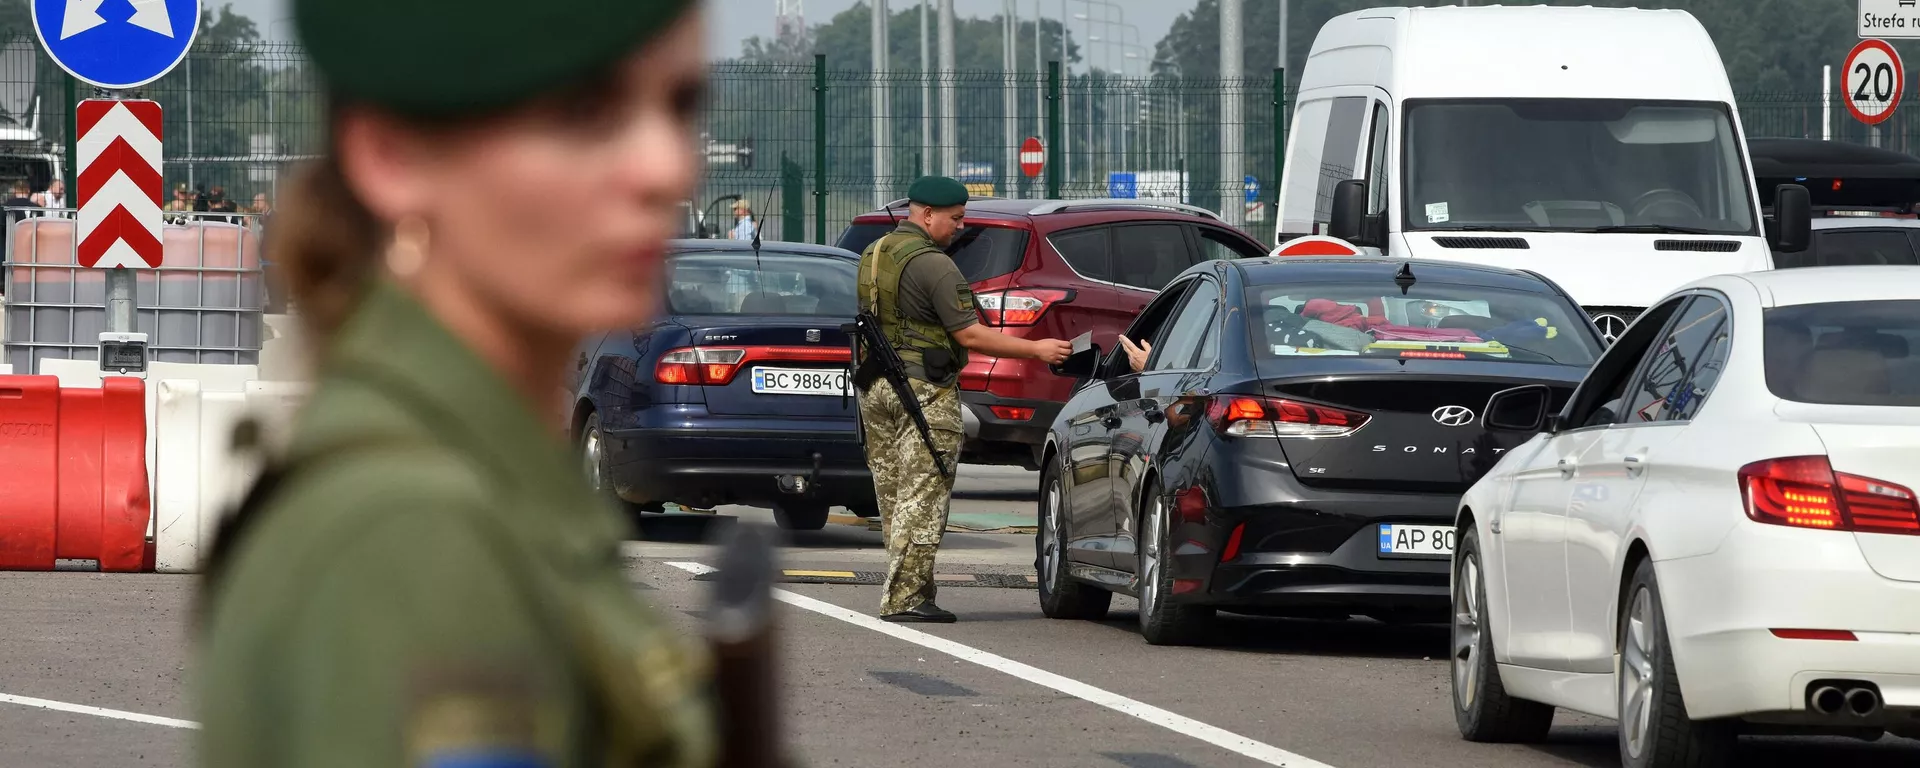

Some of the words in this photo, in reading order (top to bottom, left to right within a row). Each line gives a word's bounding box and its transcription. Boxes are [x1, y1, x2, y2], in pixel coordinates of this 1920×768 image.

[1863, 13, 1905, 28] Strefa
[1853, 62, 1893, 102] 20
[765, 373, 788, 389] BC
[793, 373, 831, 390] 9884
[1395, 529, 1425, 549] AP
